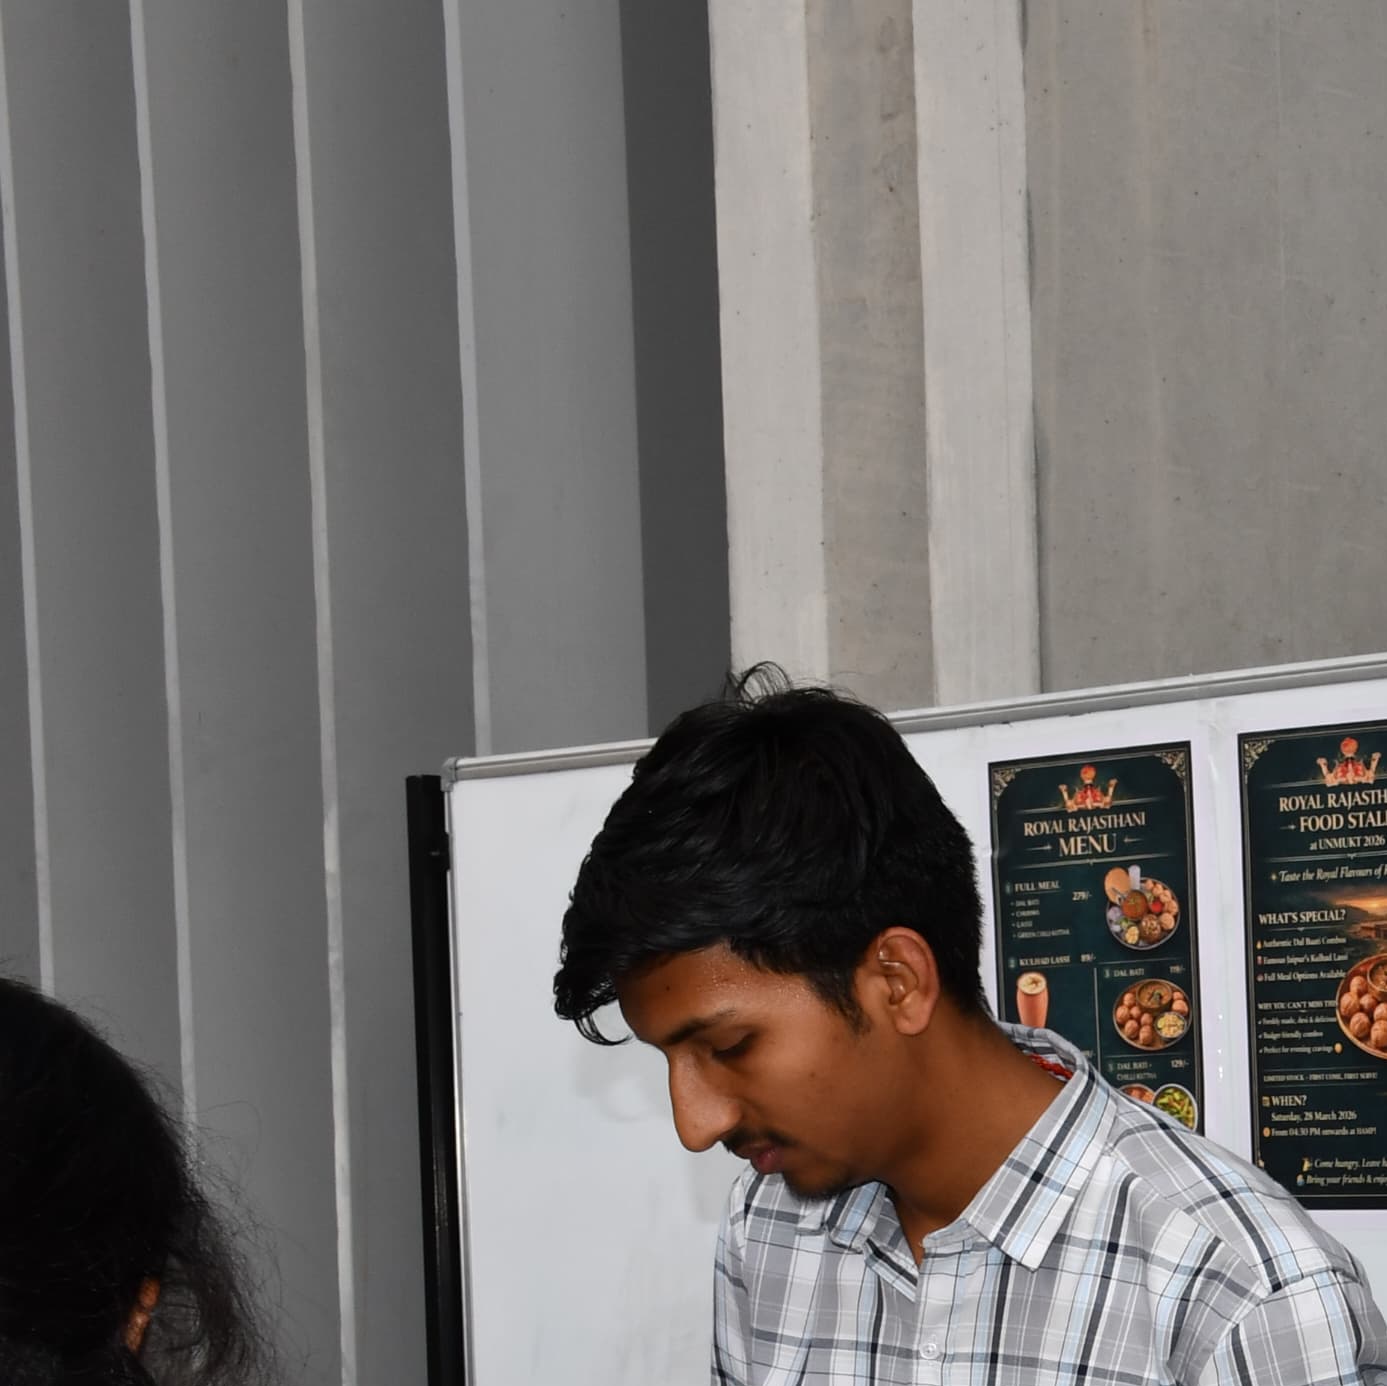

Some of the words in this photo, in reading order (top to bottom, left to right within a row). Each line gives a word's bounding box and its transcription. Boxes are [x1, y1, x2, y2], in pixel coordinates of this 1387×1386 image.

[1279, 794, 1324, 813] ROYAL
[1023, 820, 1065, 836] ROYAL
[1068, 812, 1146, 833] RAJASTHANI
[1300, 814, 1344, 833] FOOD
[1059, 833, 1117, 857] MENU
[1309, 841, 1317, 850] at
[1318, 836, 1362, 850] UNMUKT
[1363, 835, 1385, 847] 2026
[1279, 870, 1301, 882] Taste
[1302, 869, 1315, 881] the
[1316, 866, 1339, 882] Royal
[1340, 866, 1372, 879] Flavours
[1374, 864, 1384, 879] of
[1015, 882, 1036, 892] FULL
[1038, 881, 1060, 890] MEAL
[1259, 912, 1298, 925] WHAT'S
[1300, 909, 1346, 922] SPECIAL?
[1271, 1095, 1307, 1106] WHEN?
[1271, 1112, 1302, 1123] Saturday,
[1314, 1111, 1337, 1120] March
[1338, 1110, 1357, 1120] 2026
[1314, 1159, 1333, 1168] Come
[1362, 1158, 1380, 1168] Leave
